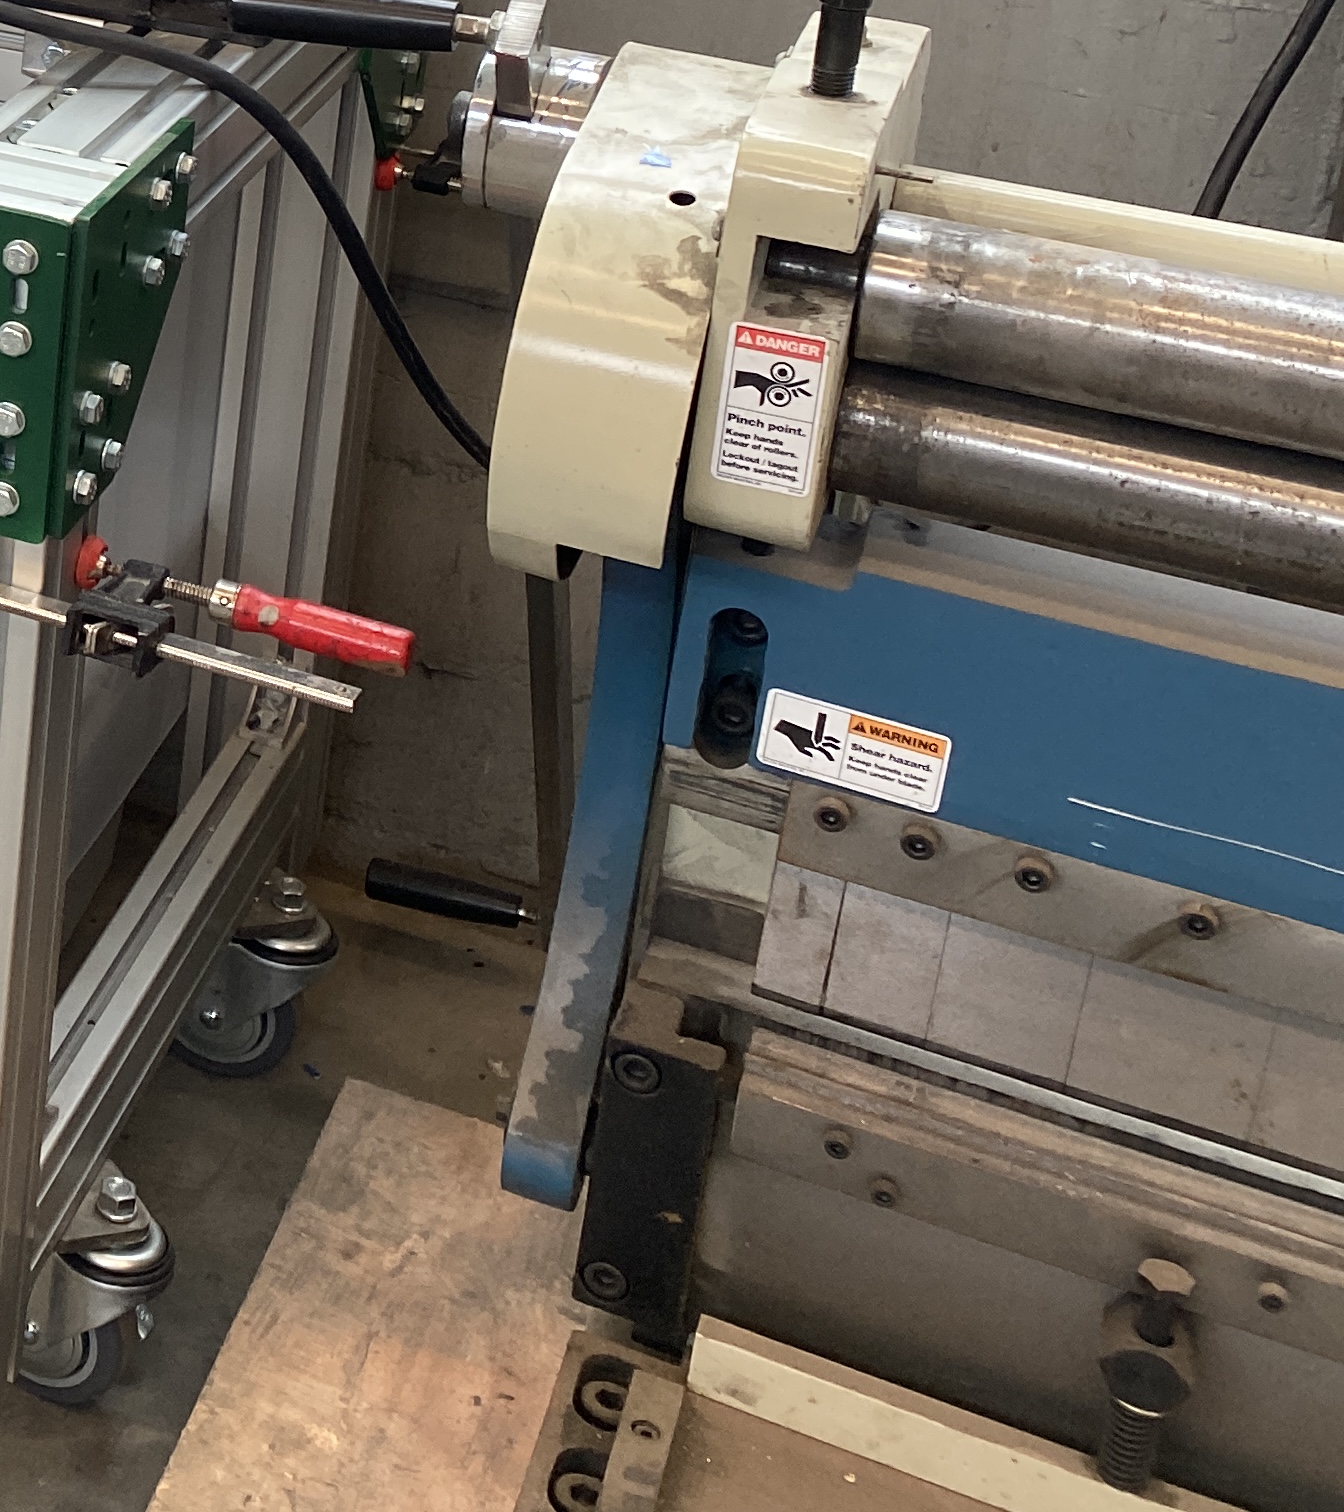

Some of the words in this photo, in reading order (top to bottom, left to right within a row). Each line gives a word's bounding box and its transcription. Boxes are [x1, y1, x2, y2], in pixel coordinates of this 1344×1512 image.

[755, 334, 821, 358] DANGER
[725, 427, 751, 440] Keep
[753, 433, 784, 446] hands
[727, 412, 765, 429] Pinch
[767, 419, 807, 438] point.
[722, 449, 760, 465] Lockout
[724, 438, 750, 450] clear
[751, 443, 762, 451] of
[763, 445, 799, 459] rollers.
[720, 459, 750, 472] before
[753, 466, 799, 483] servicing.
[869, 725, 939, 754] WARNING
[848, 755, 871, 768] Keep
[874, 763, 901, 776] hands
[903, 771, 928, 783] clear
[850, 742, 886, 759] Shear
[889, 753, 933, 773] hazard.
[846, 763, 867, 775] from
[869, 769, 895, 783] under
[897, 778, 925, 792] blade.
